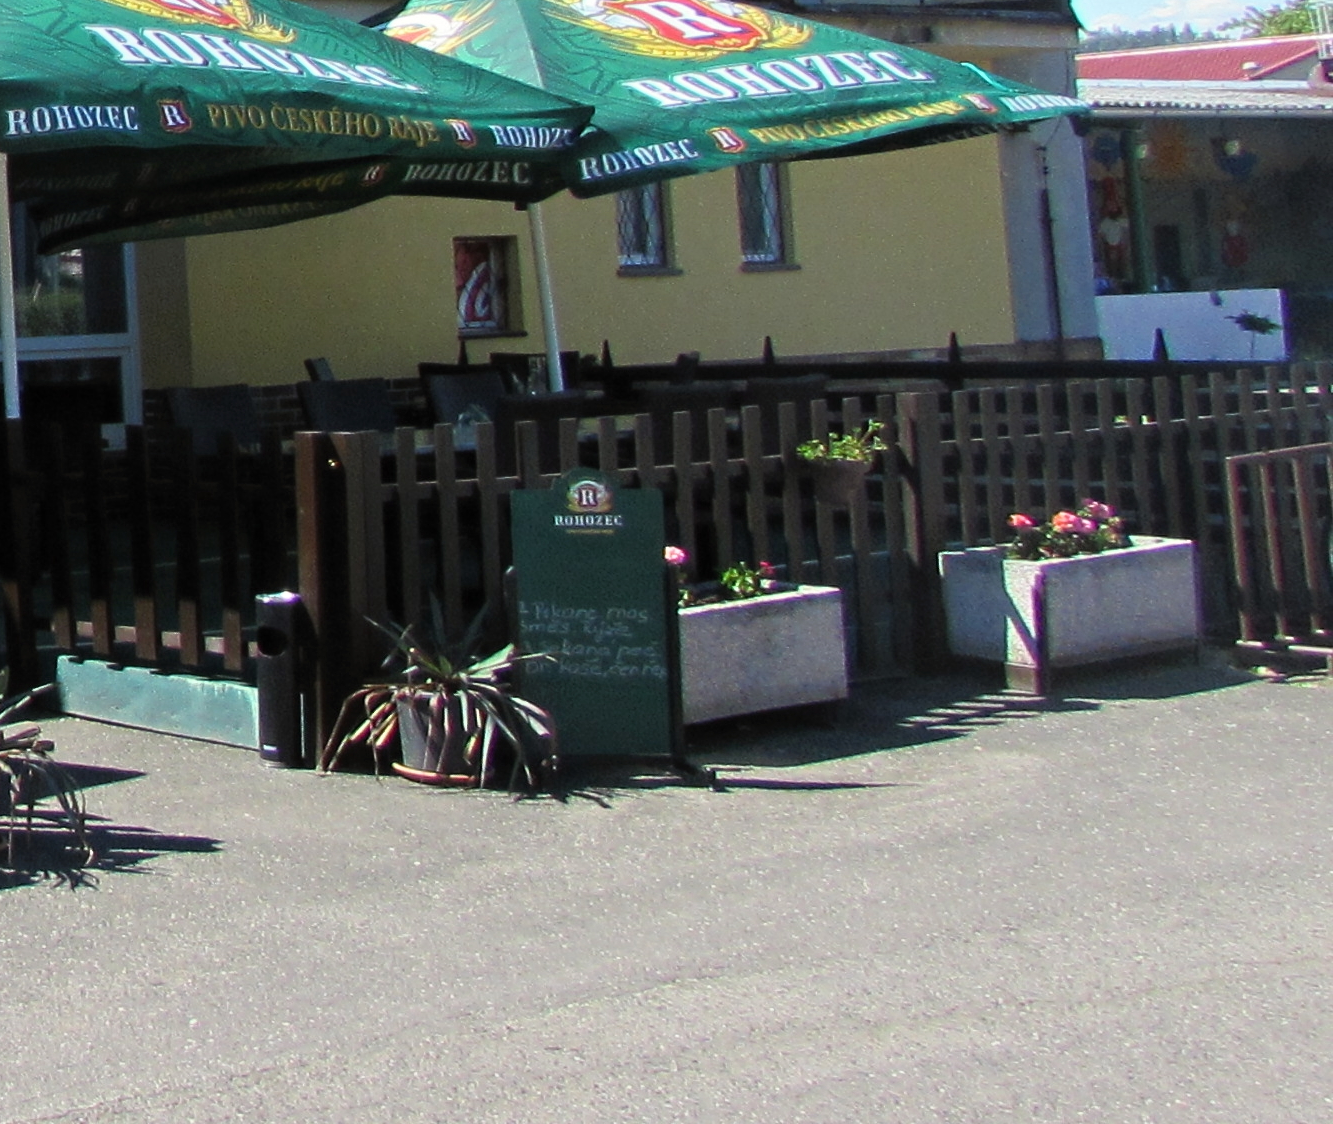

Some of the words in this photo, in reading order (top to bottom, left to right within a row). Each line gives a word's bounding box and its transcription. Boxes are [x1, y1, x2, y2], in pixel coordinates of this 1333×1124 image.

[624, 1, 743, 40] R
[84, 23, 431, 94] ROHOZEC
[620, 50, 936, 109] ROHOZEC
[6, 105, 139, 137] ROHOZEC
[207, 103, 262, 131] PIVO
[270, 100, 380, 138] ČESKÉHO
[402, 160, 530, 185] ROHOZEC
[578, 138, 702, 180] ROHOZEC
[554, 514, 624, 527] ROHOZEC
